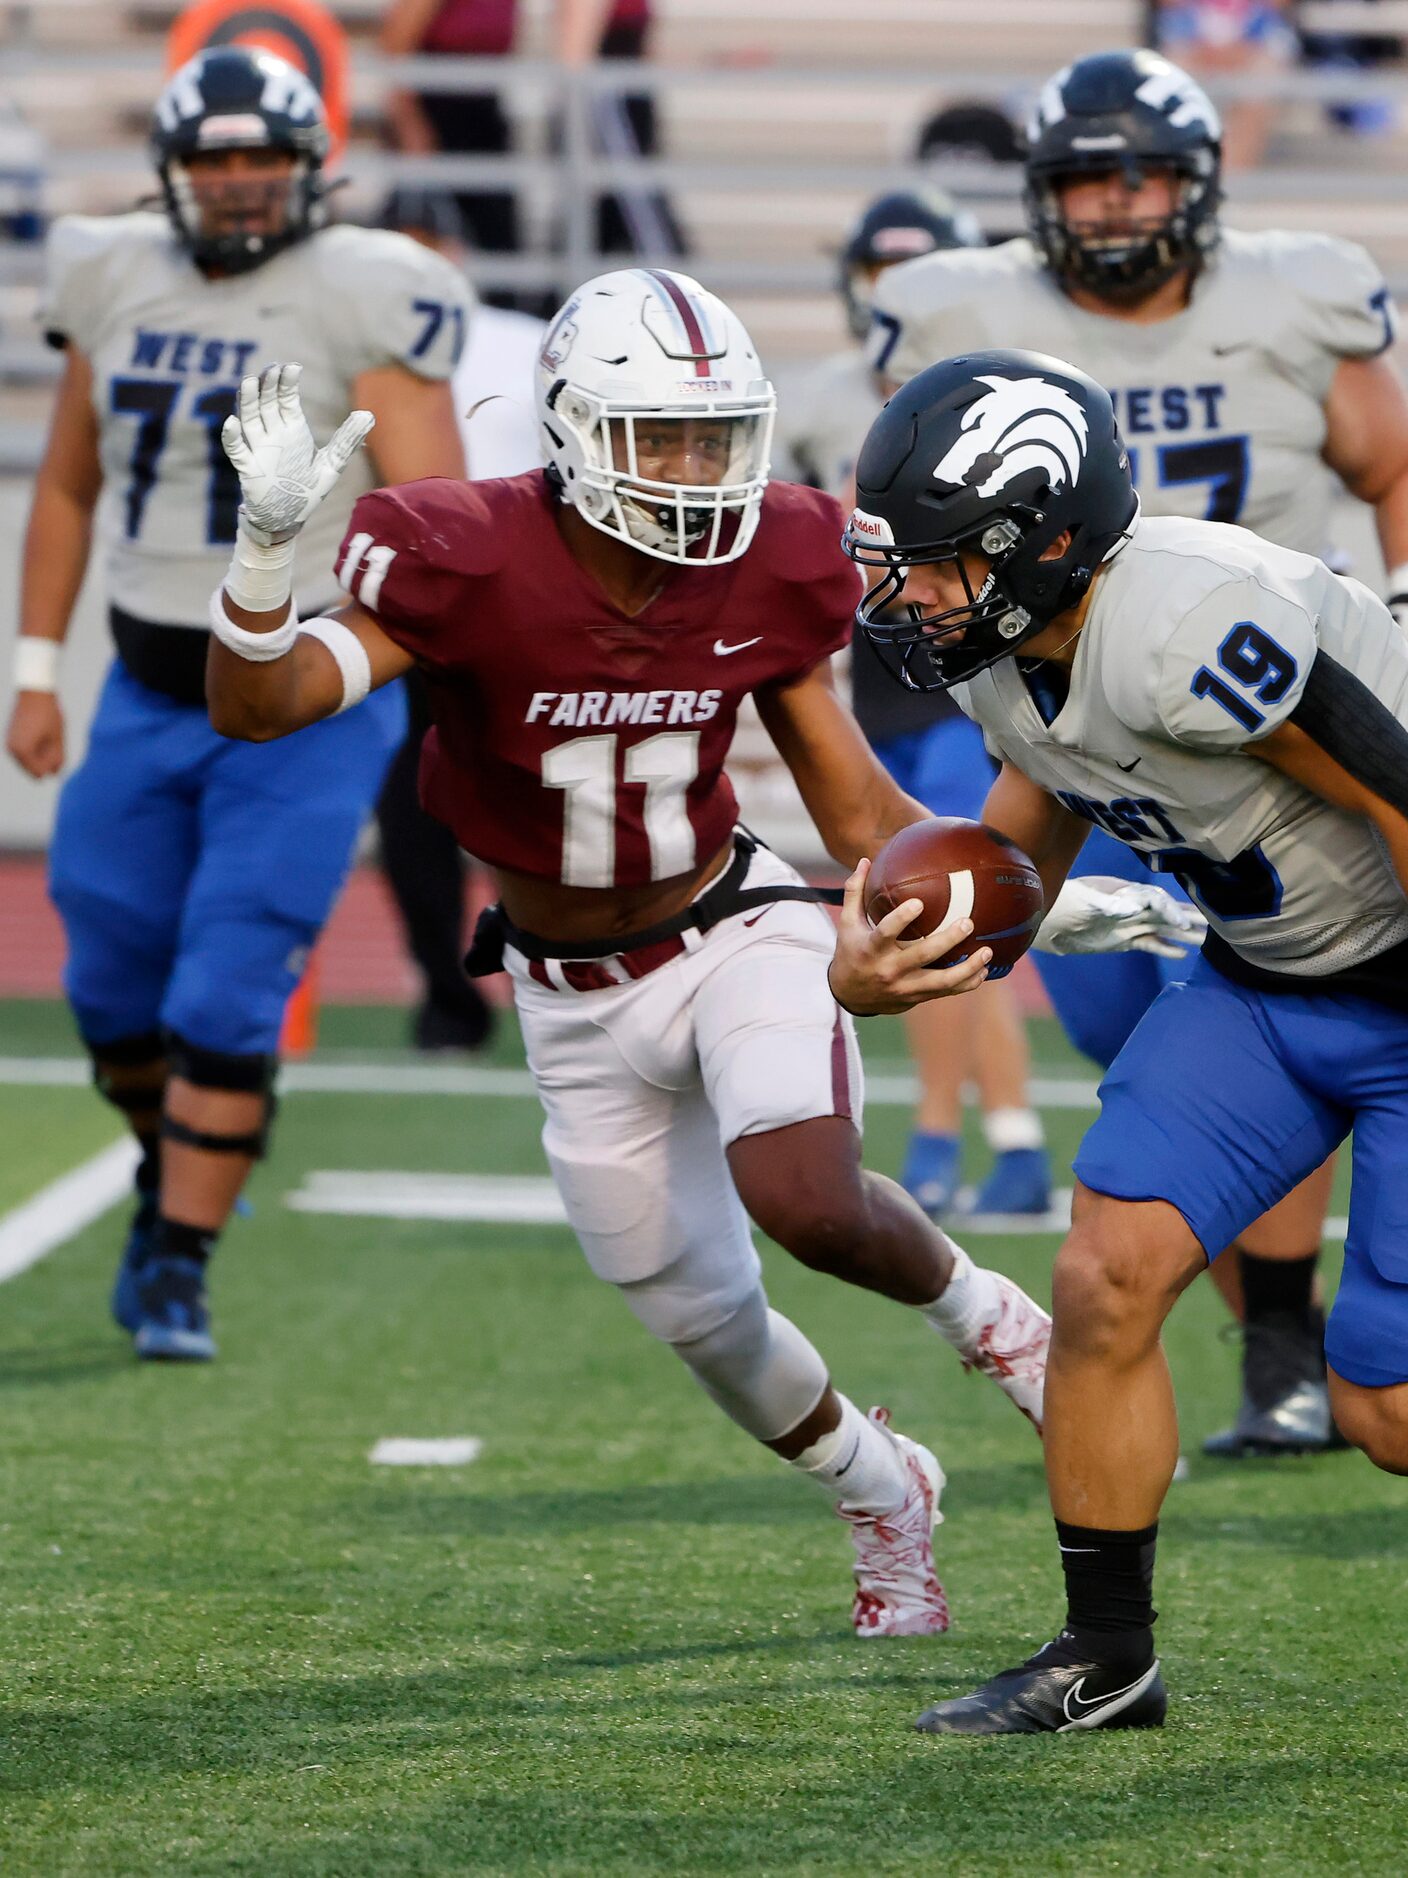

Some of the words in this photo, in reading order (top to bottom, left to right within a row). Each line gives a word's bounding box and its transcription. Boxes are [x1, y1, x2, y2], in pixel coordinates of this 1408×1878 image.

[131, 326, 260, 376] WEST
[410, 299, 466, 366] 71
[110, 375, 240, 547] 71
[1130, 435, 1251, 524] 7
[335, 532, 398, 613] 11
[525, 689, 724, 728] FARMERS
[1190, 620, 1299, 734] 19
[541, 730, 701, 889] 11
